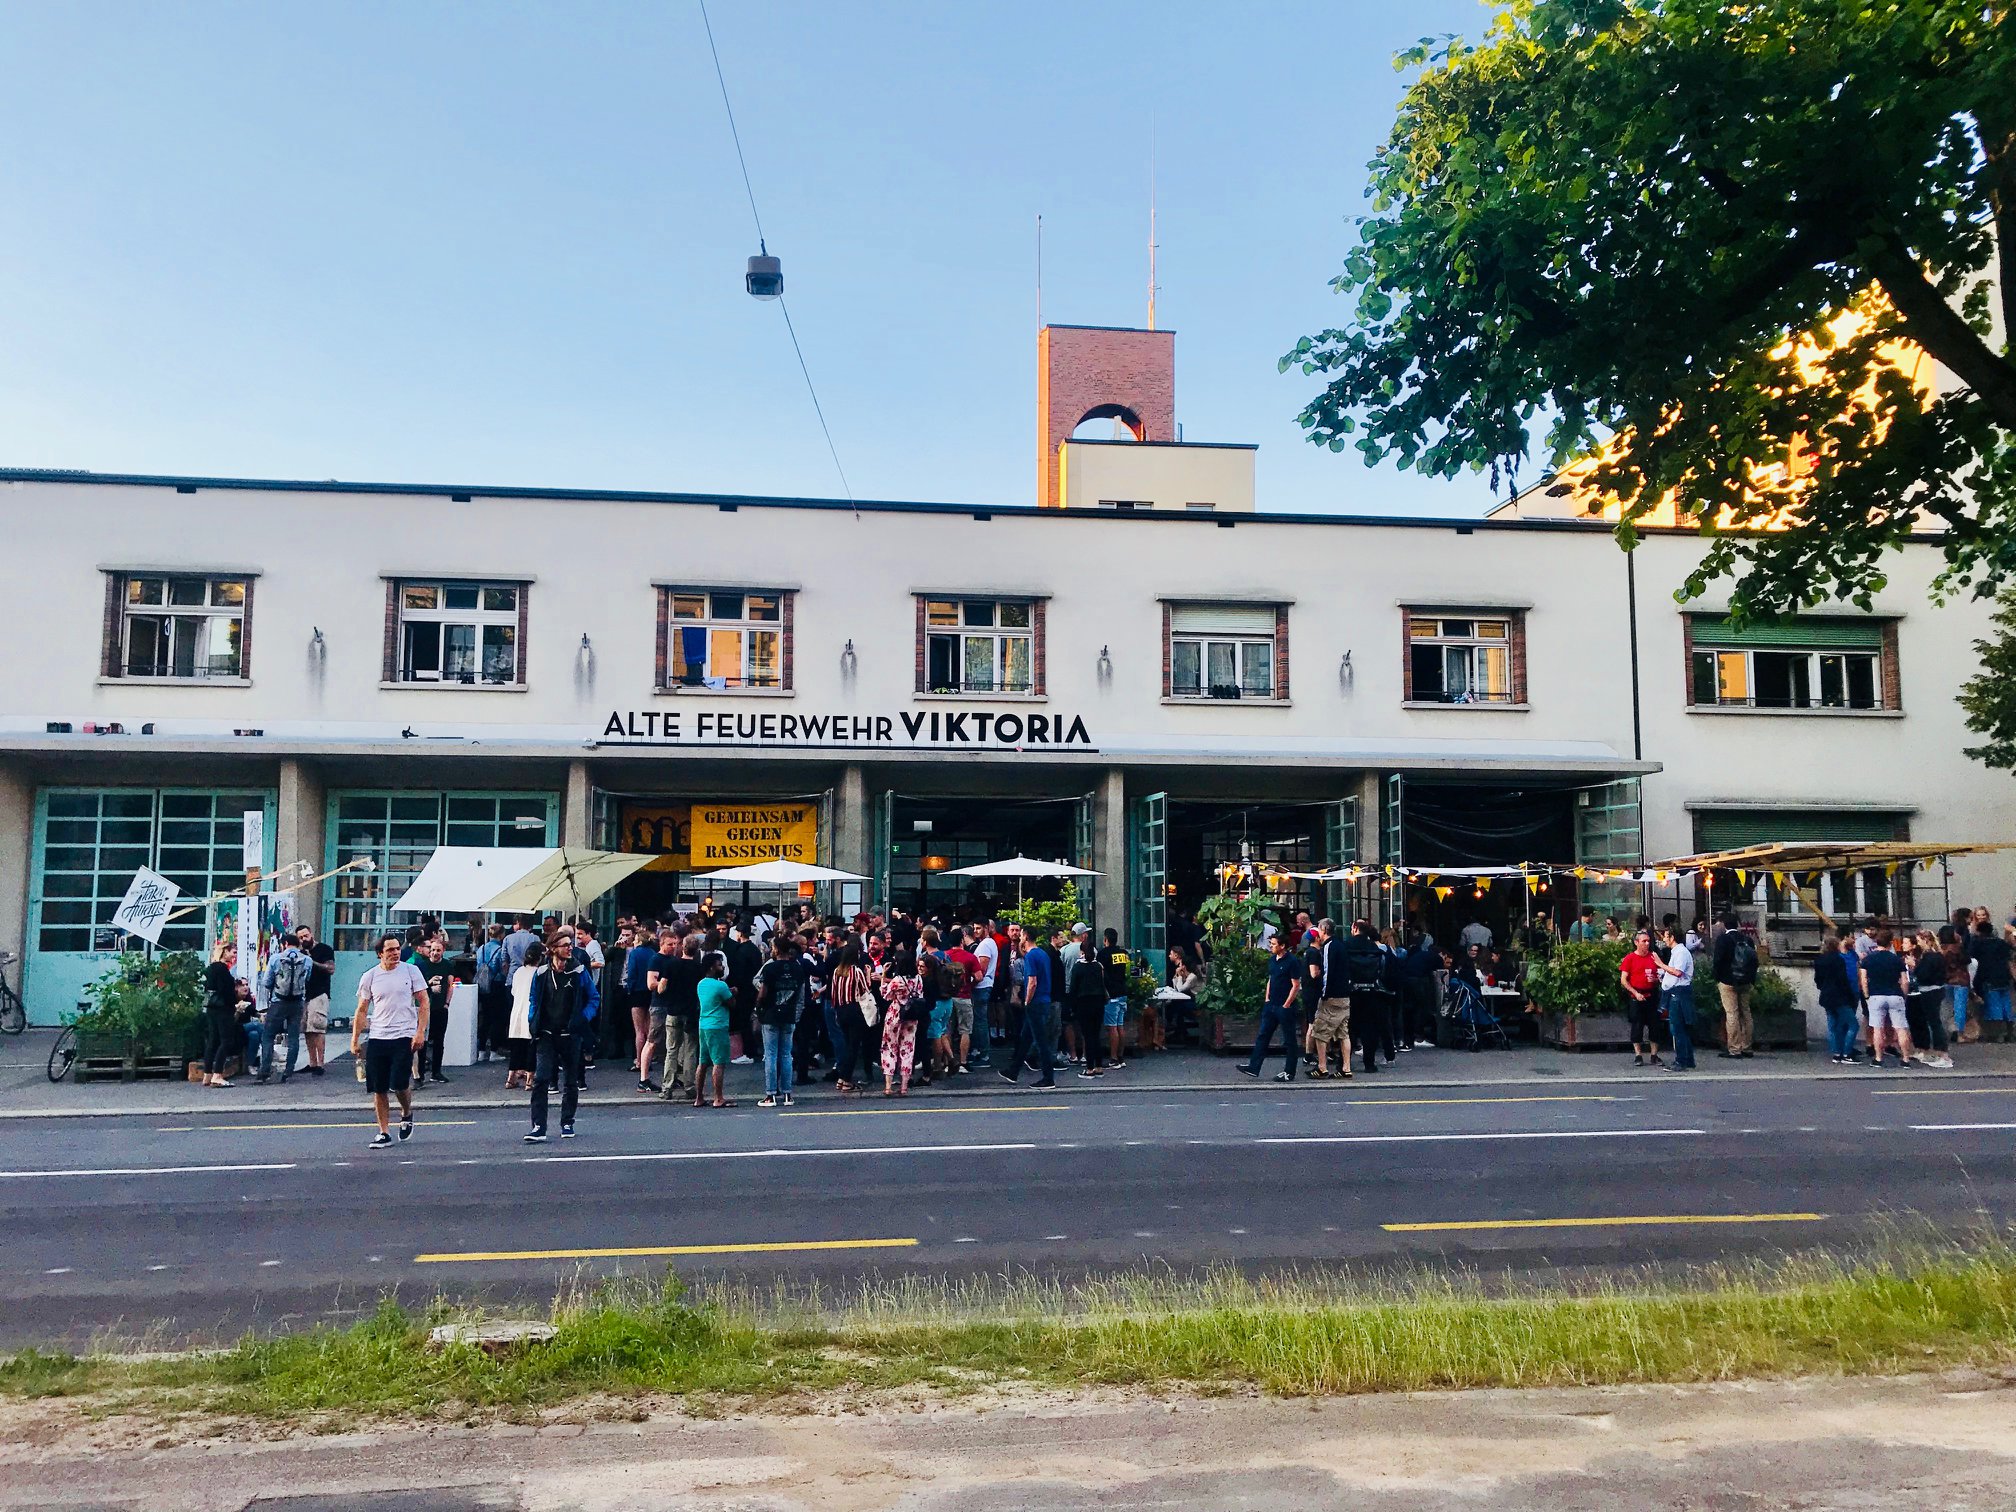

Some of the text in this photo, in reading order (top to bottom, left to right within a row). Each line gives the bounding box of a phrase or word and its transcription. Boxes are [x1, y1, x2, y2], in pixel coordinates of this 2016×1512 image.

[604, 711, 1091, 743] ALTE FEUERWEHR VIKTORIA
[704, 810, 804, 824] GEMEINSAM
[727, 828, 782, 841] GEGEN
[705, 844, 803, 858] RASSISMUS
